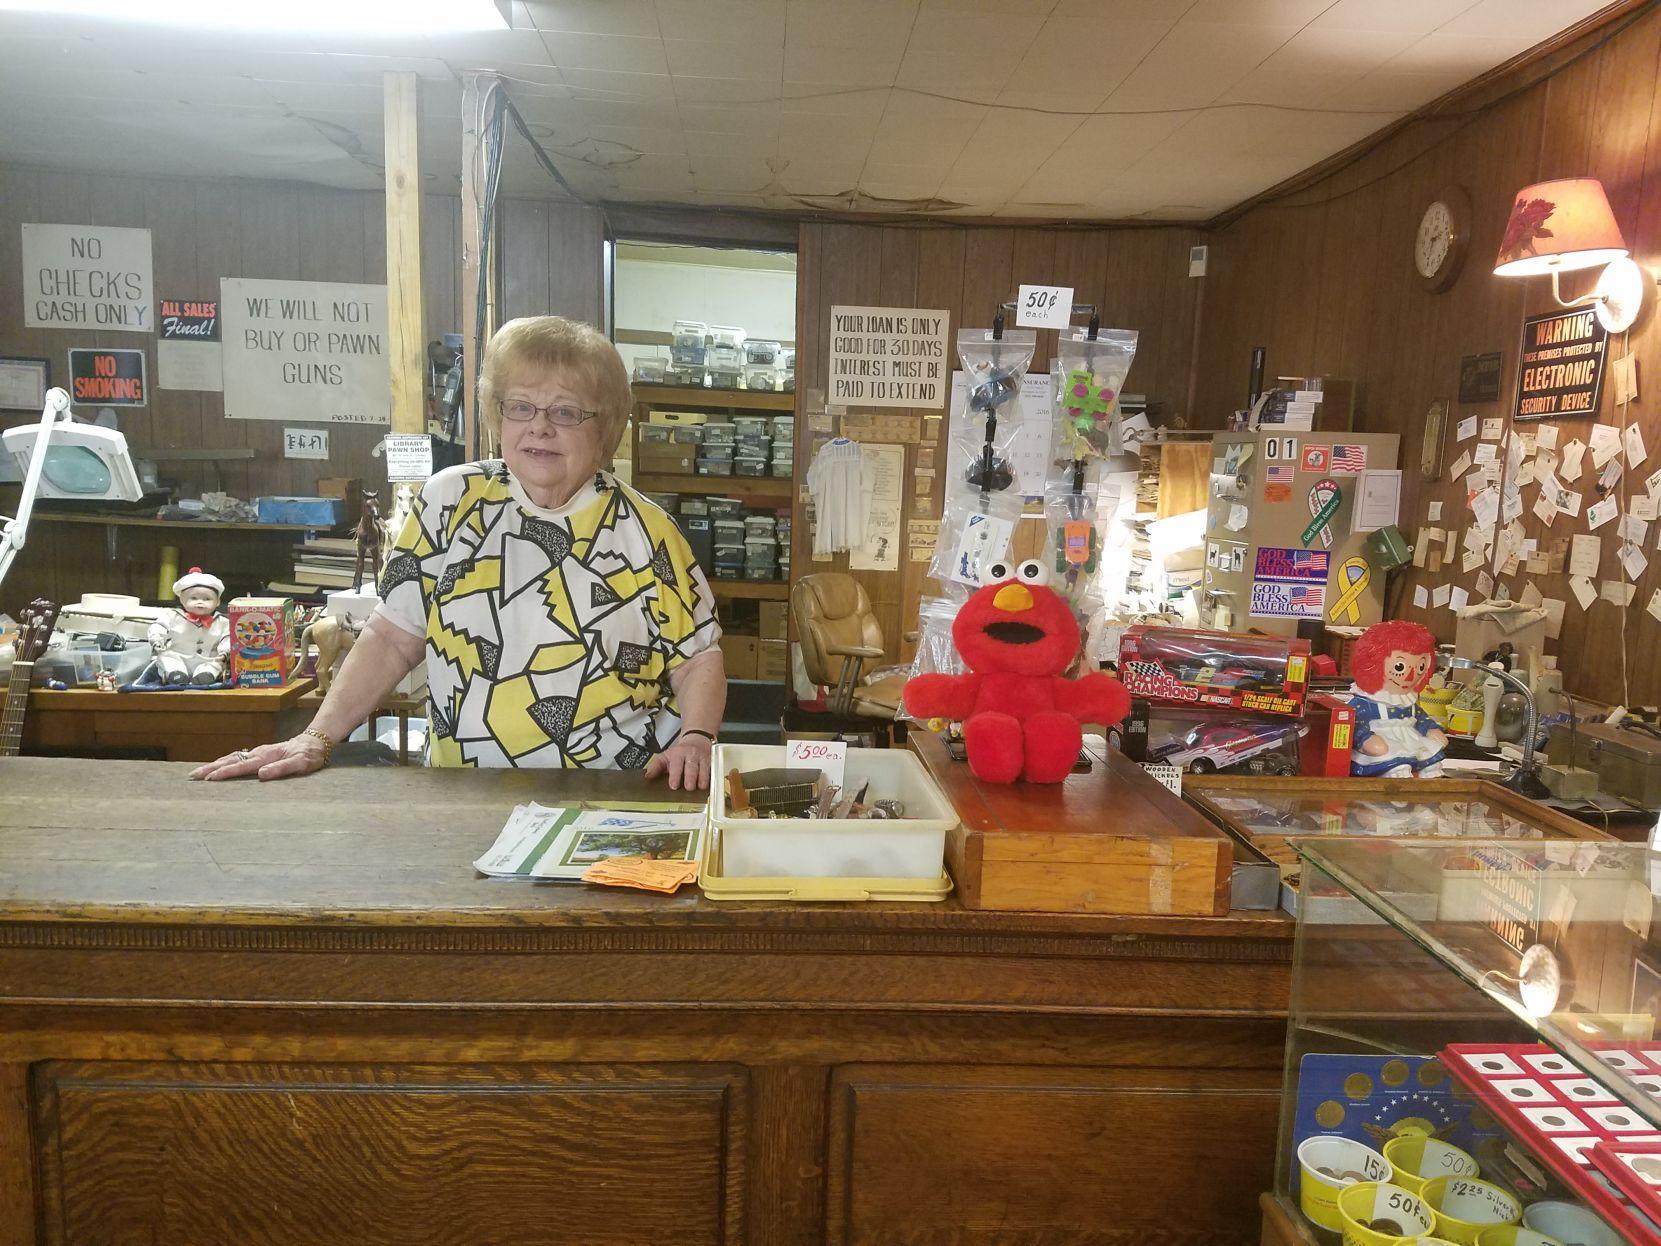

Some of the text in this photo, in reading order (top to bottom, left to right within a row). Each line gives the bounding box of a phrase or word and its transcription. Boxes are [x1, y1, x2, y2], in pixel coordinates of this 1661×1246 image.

[70, 237, 102, 260] NO
[39, 268, 142, 301] CHECKS
[161, 301, 217, 318] ALL SALES
[246, 297, 374, 323] WE WILL NOT
[1025, 290, 1059, 311] 50¢
[36, 300, 147, 326] CASH ONLY
[1025, 309, 1049, 319] each
[163, 317, 216, 338] Final!
[835, 314, 941, 336] YOUR LOAN IS ONLY
[1537, 313, 1594, 345] WARNING
[244, 328, 381, 355] BUY OR PAWN
[834, 336, 943, 357] GOOD FOR 30 DAYS
[1538, 349, 1562, 360] PREMISES
[1563, 343, 1592, 356] PROTECTED
[1595, 342, 1603, 352] BY
[93, 355, 117, 377] NO
[282, 362, 344, 386] GUNS
[834, 358, 941, 379] INTEREST MUST BE
[1524, 360, 1595, 391] ELECTRONIC
[74, 377, 142, 400] SMOKING
[836, 380, 936, 400] PAID TO EXTEND
[1521, 392, 1591, 414] SECURITY DEVICE
[331, 414, 367, 422] POSTED
[1303, 530, 1313, 541] God
[1311, 518, 1324, 532] Bless
[1321, 499, 1339, 520] America
[1258, 558, 1293, 568] BLESS
[1259, 549, 1287, 560] GOD
[1256, 566, 1311, 577] AMERICA
[1252, 593, 1289, 604] BLESS
[1253, 584, 1281, 594] GOD
[1251, 602, 1306, 612] AMERICA
[1123, 671, 1174, 687] RACING
[1123, 682, 1199, 701] CHAMPIONS
[1486, 1191, 1510, 1210] Silver
